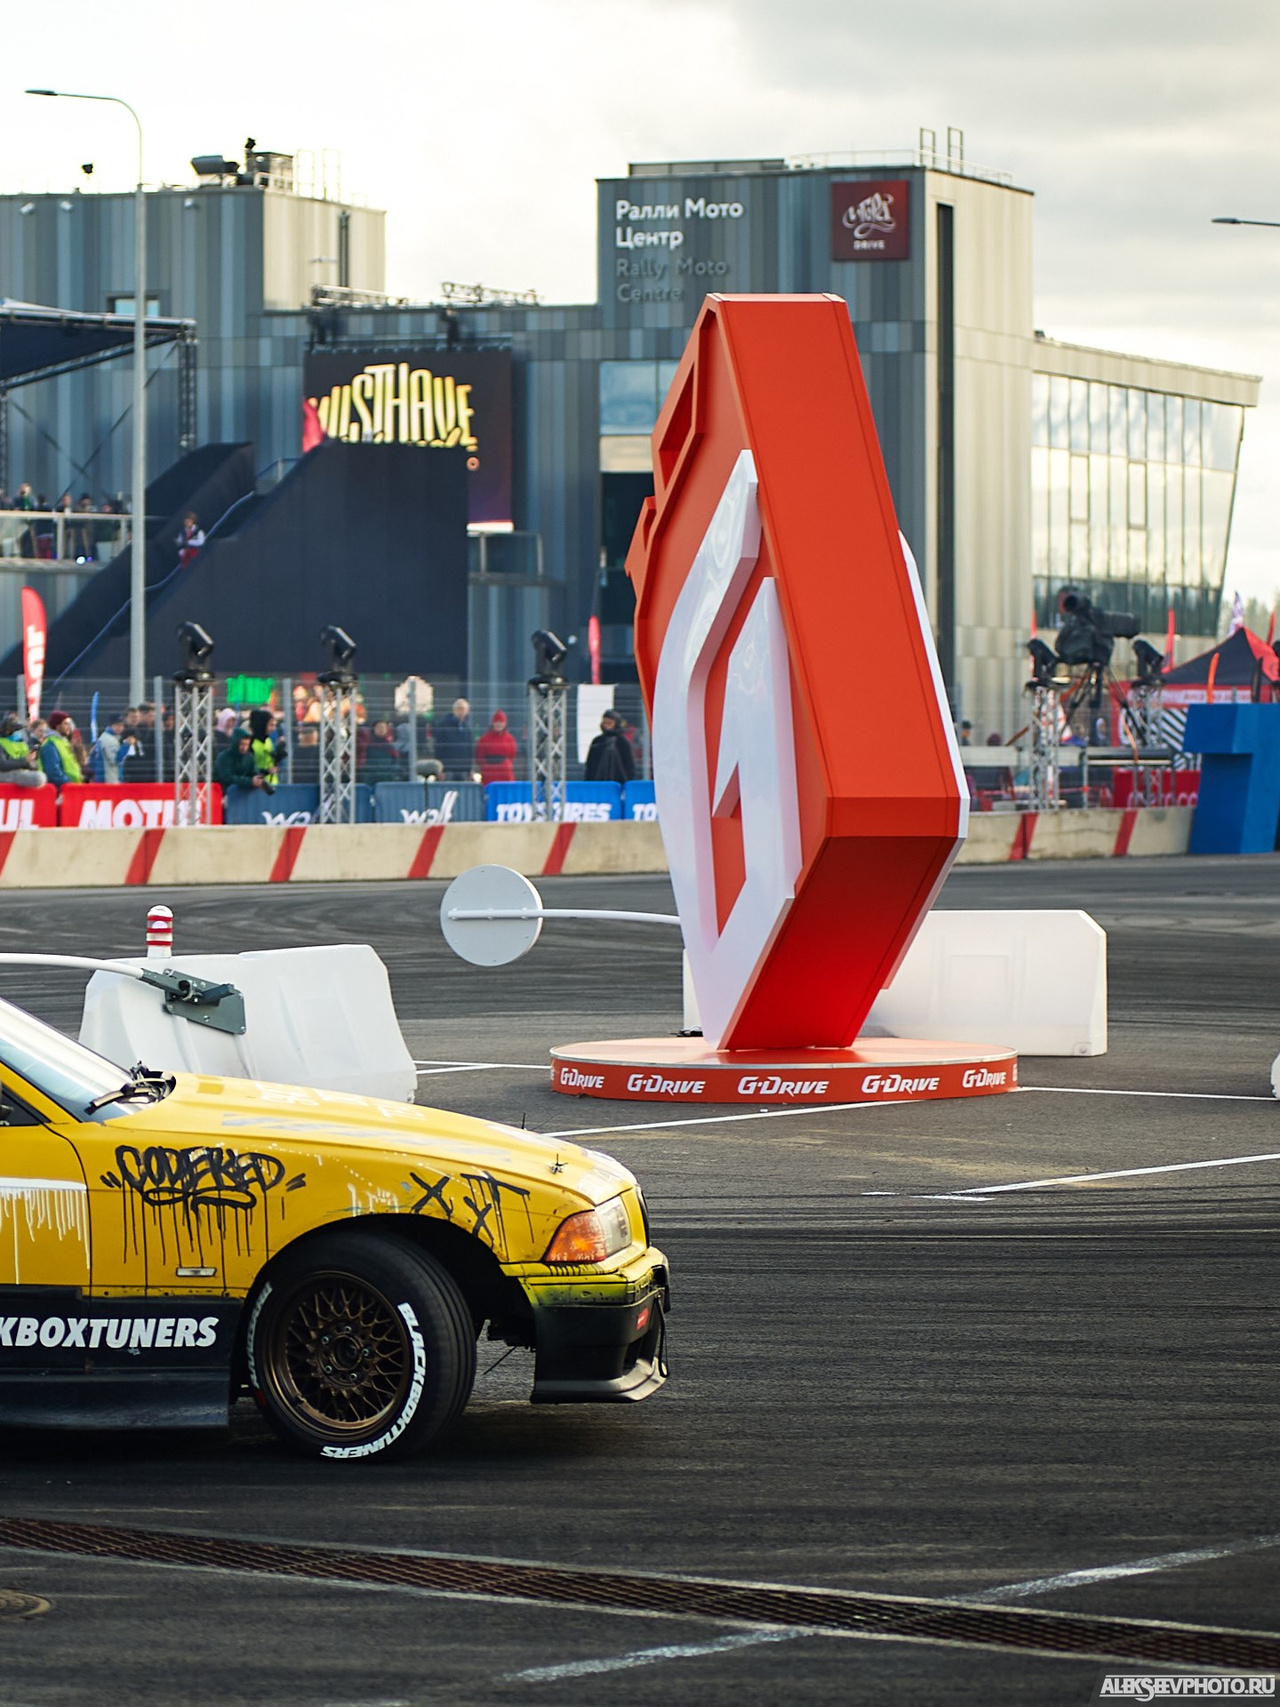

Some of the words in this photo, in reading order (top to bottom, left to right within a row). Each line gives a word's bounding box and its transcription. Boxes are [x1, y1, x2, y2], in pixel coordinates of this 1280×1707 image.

[616, 200, 680, 221] Ралли
[684, 198, 744, 218] Мото
[616, 226, 684, 249] Центр
[616, 258, 668, 280] Rally
[676, 257, 729, 276] Moto
